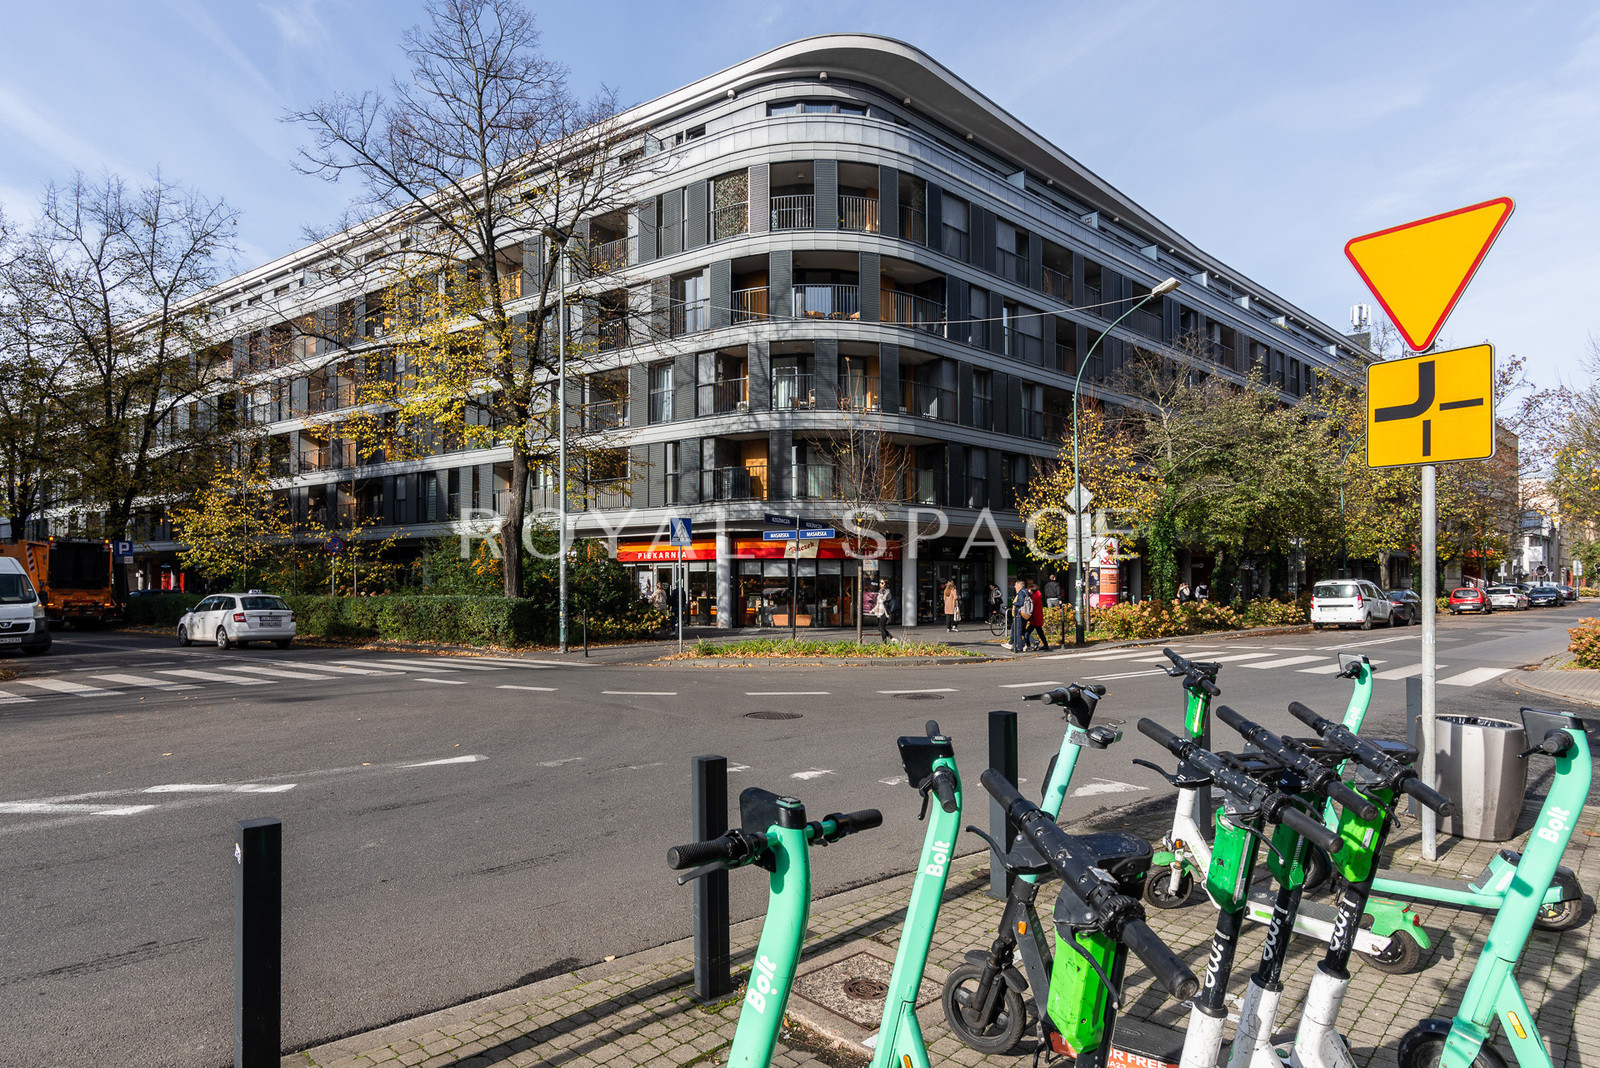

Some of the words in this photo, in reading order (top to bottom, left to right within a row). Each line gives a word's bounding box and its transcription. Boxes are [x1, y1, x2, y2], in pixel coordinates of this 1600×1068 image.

[118, 542, 130, 555] P
[1344, 706, 1362, 728] Bolt
[1537, 806, 1570, 844] Bolt
[925, 840, 951, 878] Bolt
[745, 954, 778, 1015] Bolt
